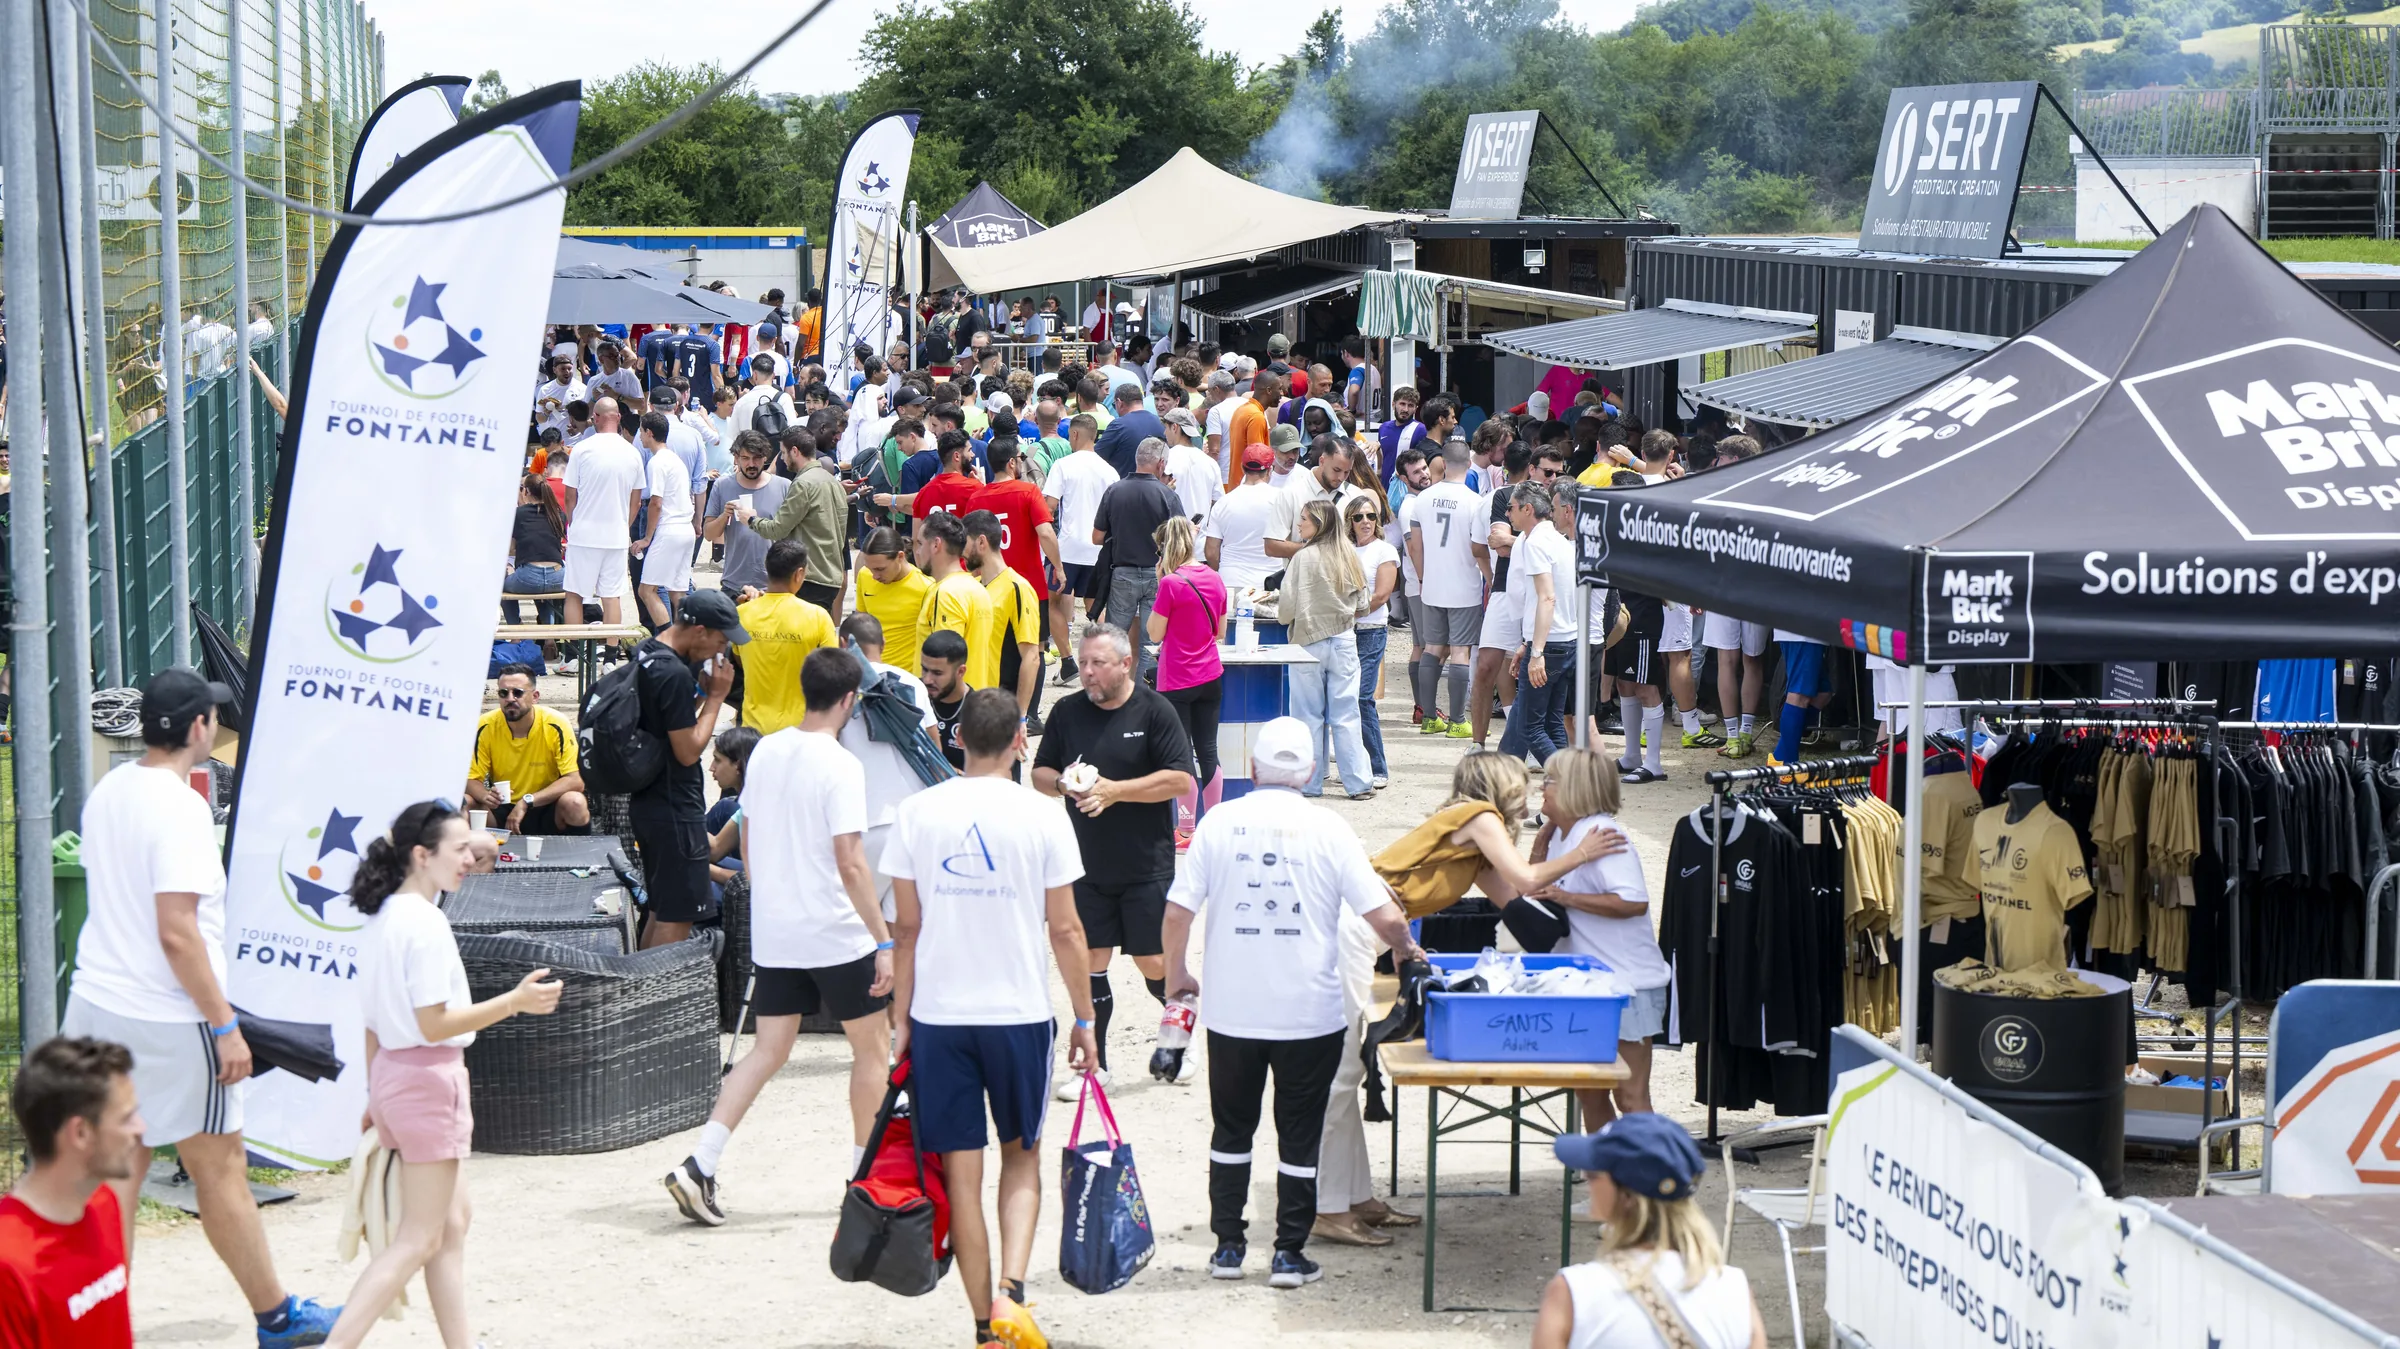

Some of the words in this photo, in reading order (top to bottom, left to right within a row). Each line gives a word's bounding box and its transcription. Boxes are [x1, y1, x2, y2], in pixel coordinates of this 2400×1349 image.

[1480, 121, 1531, 167] SERT
[1917, 98, 2021, 171] SERT
[1487, 172, 1520, 182] EXPERIENCE
[1911, 179, 1958, 195] FOODTRUCK
[1959, 180, 2001, 196] CREATION
[968, 222, 1017, 235] Mark
[976, 230, 1012, 243] Bric
[1872, 218, 1900, 236] Solutions
[1900, 219, 1909, 236] de
[1909, 219, 1960, 239] RESTAURATION
[1960, 222, 1991, 240] MOBILE
[688, 354, 696, 377] 3
[329, 399, 399, 419] TOURNOI
[406, 410, 423, 422] DE
[430, 412, 499, 430] FOOTBALL
[1911, 374, 2019, 427] ark
[326, 415, 496, 452] FONTANEL
[2284, 478, 2400, 511] Disp
[1436, 512, 1451, 547] 7
[1618, 502, 1680, 547] Solutions
[1681, 512, 1769, 563] d'exposition
[1770, 531, 1853, 583] innovantes
[1941, 569, 2013, 597] Mark
[2081, 551, 2279, 595] Solutions
[748, 630, 802, 642] ORCELANOSA
[1947, 629, 2010, 647] Display
[287, 665, 352, 681] TOURNOI
[358, 672, 376, 684] DE
[384, 676, 453, 700] FOOTBALL
[284, 680, 449, 721] FONTANEL
[241, 928, 309, 948] TOURNOI
[316, 940, 333, 952] DE
[237, 943, 358, 980] FONTAN
[1487, 1012, 1554, 1034] GANTS
[1568, 1011, 1589, 1034] L
[1835, 1193, 1867, 1245] DES
[2028, 1249, 2082, 1316] FOOT
